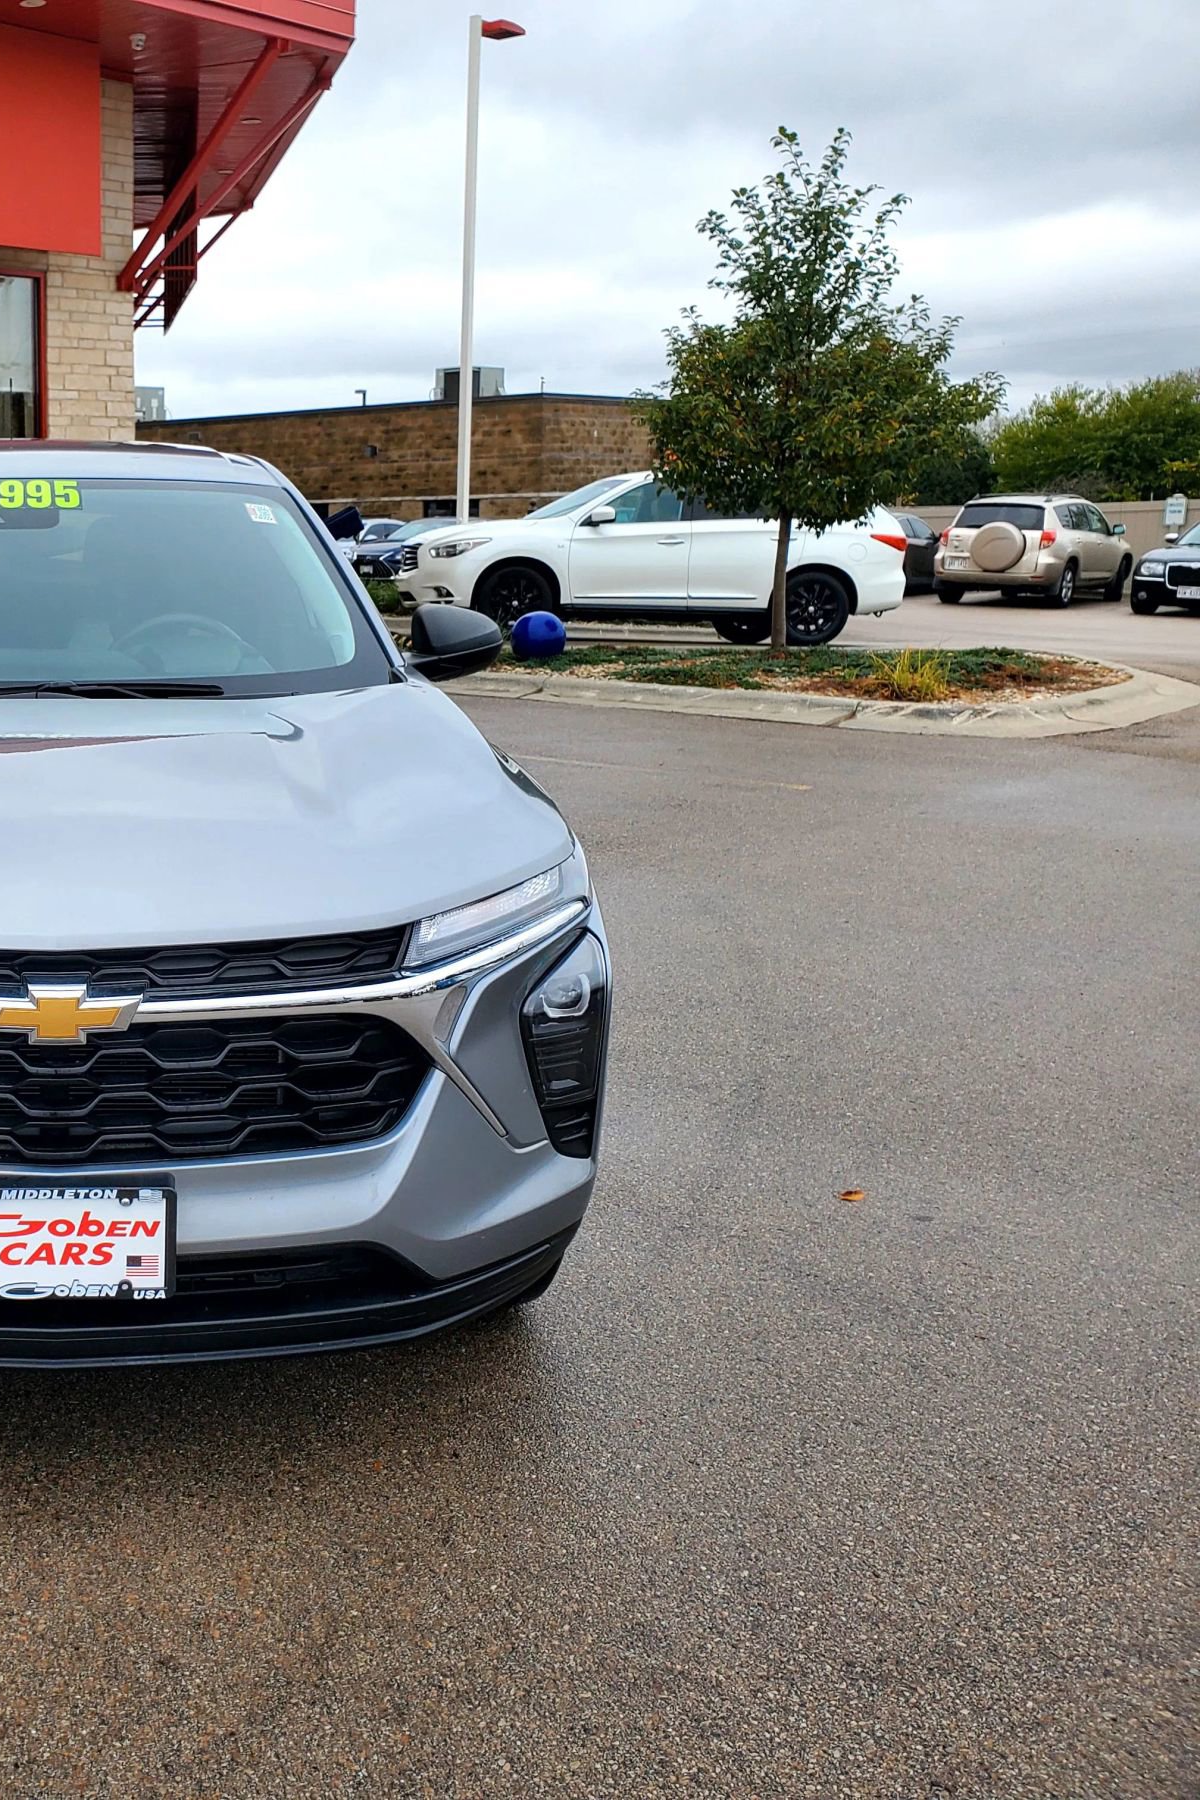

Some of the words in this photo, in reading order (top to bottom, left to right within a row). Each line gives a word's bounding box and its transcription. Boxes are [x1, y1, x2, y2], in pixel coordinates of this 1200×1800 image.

[0, 1189, 118, 1200] MIDDLETON
[0, 1242, 116, 1266] CARS
[133, 1289, 166, 1300] USA
